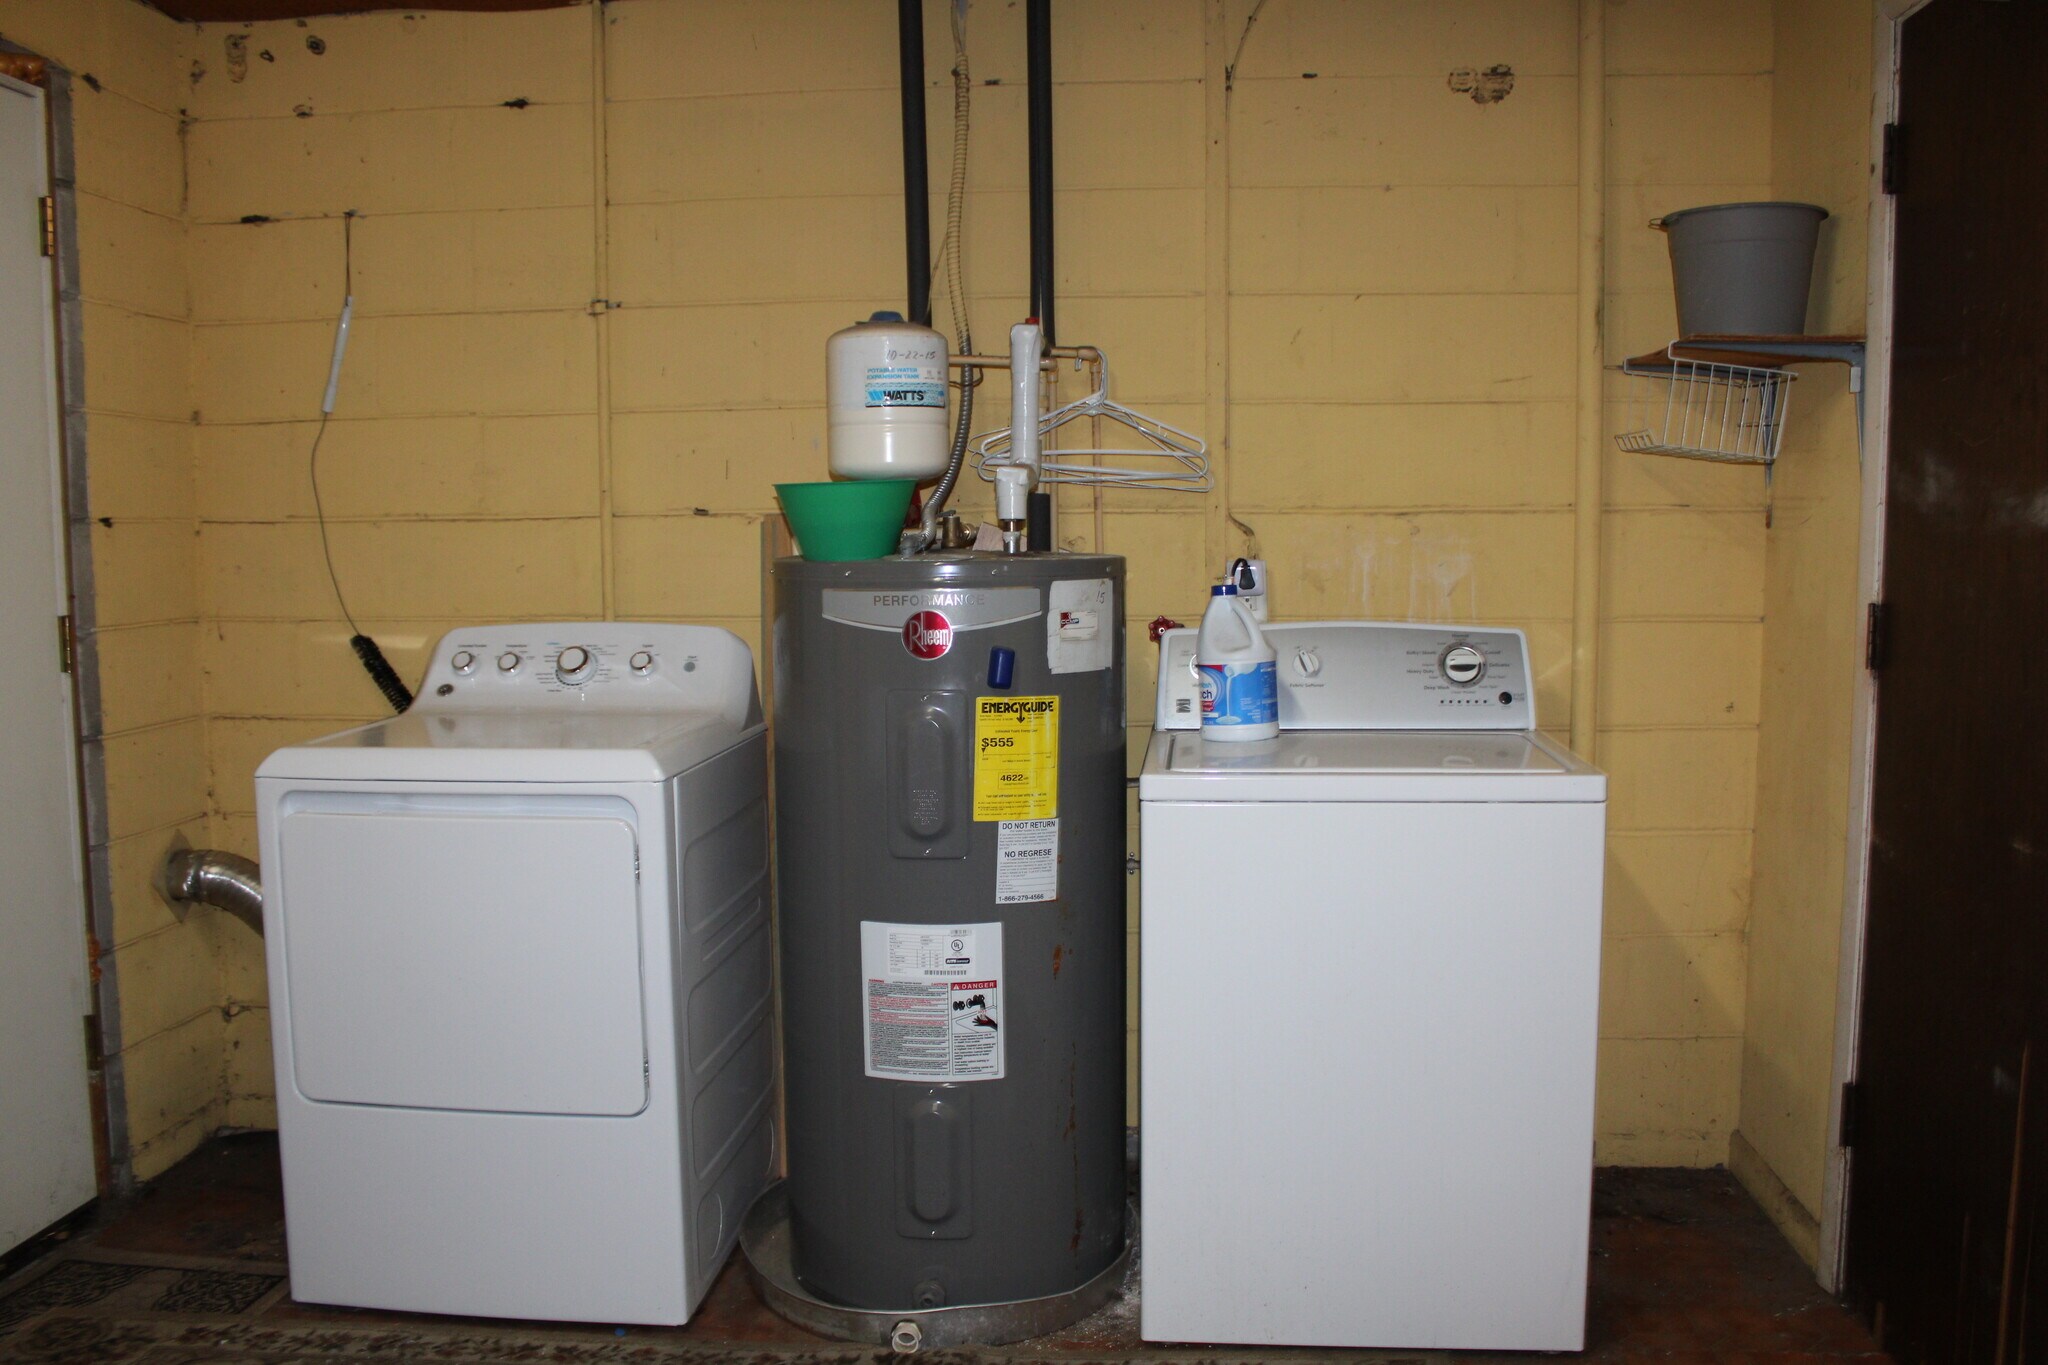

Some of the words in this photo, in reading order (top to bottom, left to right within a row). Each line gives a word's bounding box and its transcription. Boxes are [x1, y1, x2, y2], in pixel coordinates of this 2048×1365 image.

[883, 390, 925, 401] WATTS
[873, 594, 985, 606] PERFORMANCE
[909, 612, 949, 652] Rheem
[981, 701, 1054, 714] ENERGYGUIDE
[981, 737, 1014, 748] $555
[1000, 774, 1023, 782] 4622
[1002, 822, 1013, 830] DO
[1030, 820, 1056, 829] RETURN
[1017, 848, 1052, 857] REGRESE
[961, 981, 994, 990] DANGER
